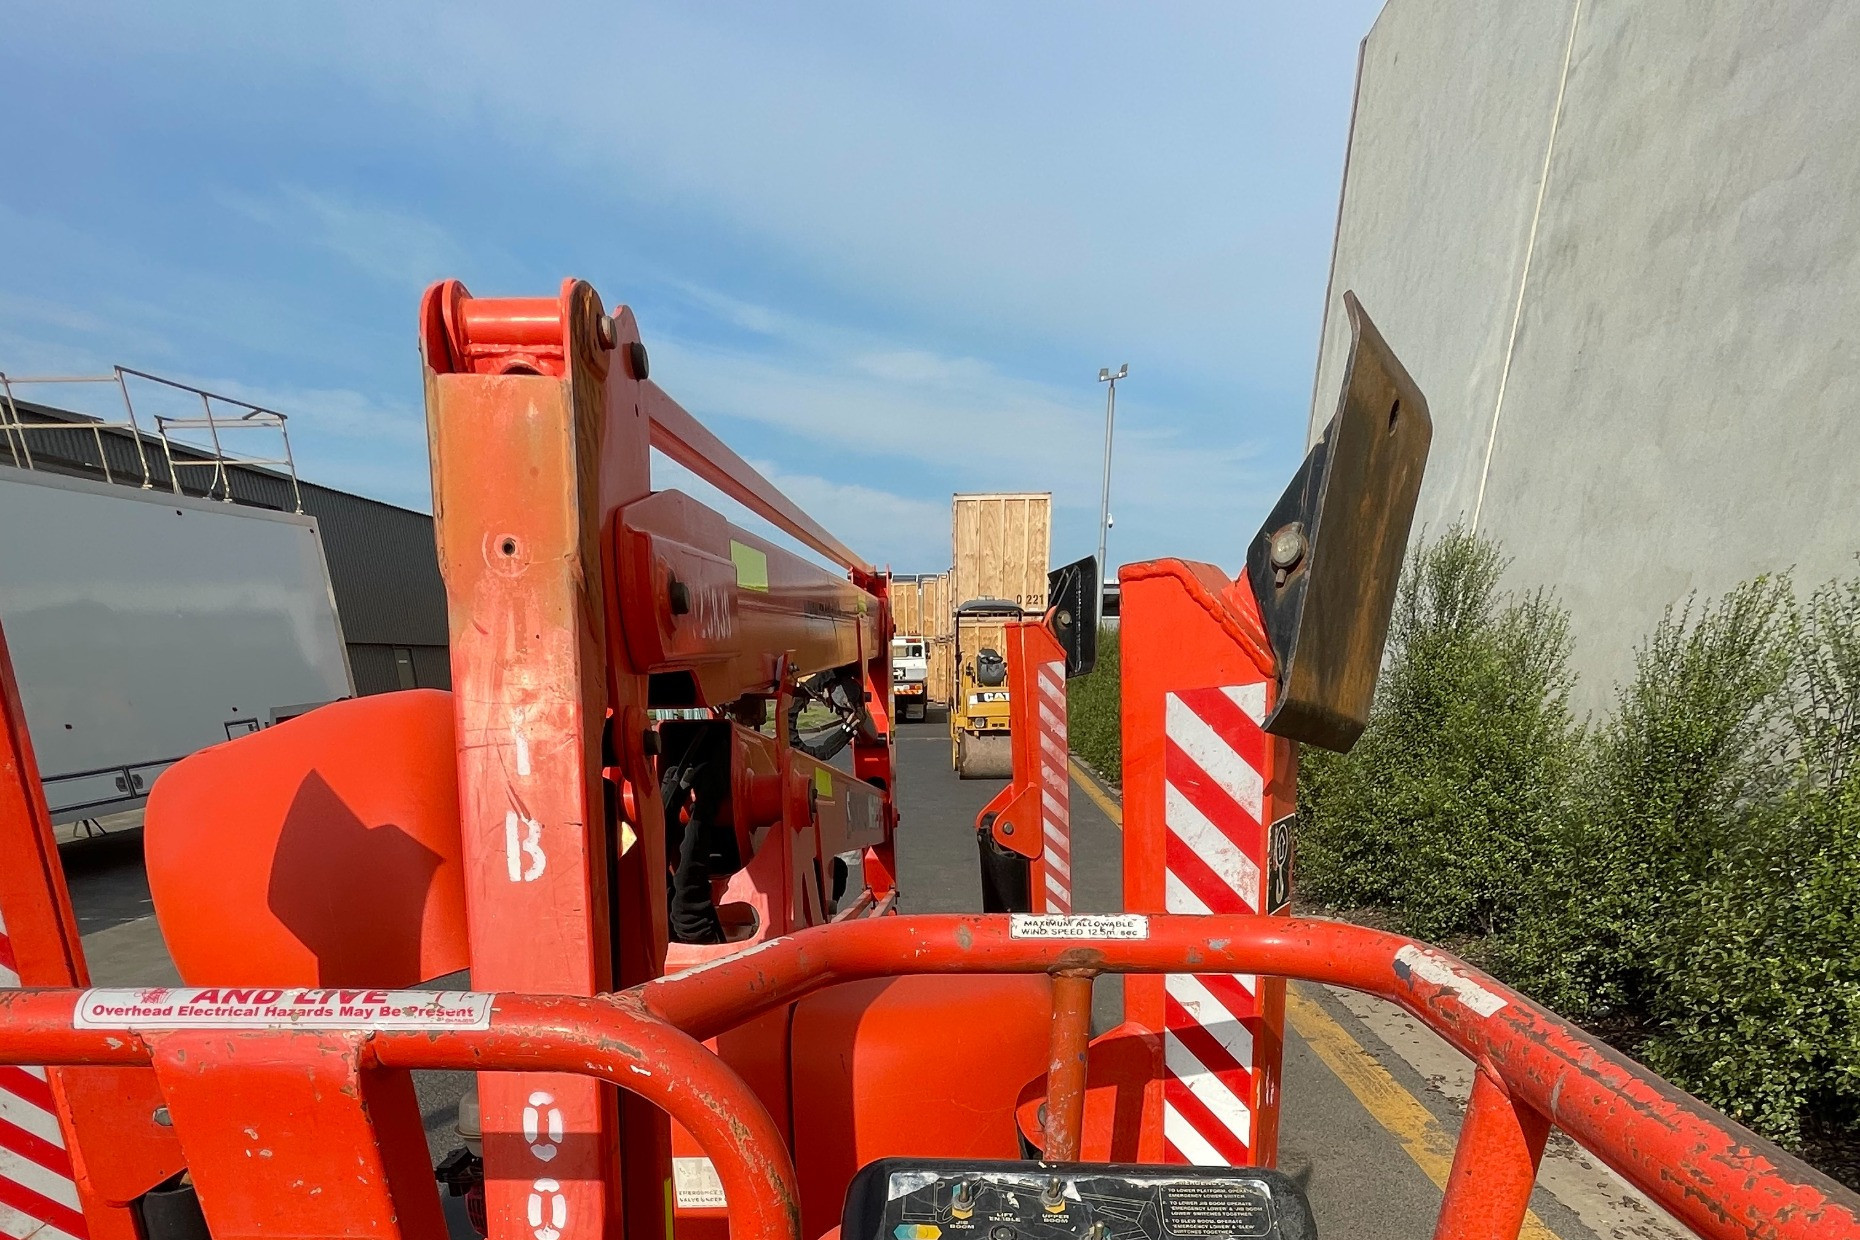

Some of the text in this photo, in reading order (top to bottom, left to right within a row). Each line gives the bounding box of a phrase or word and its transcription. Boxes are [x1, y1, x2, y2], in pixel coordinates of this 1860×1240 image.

[1026, 594, 1044, 605] 221
[984, 692, 1010, 702] CAT
[1076, 920, 1134, 928] ALLOWABLE
[1021, 928, 1048, 936] WIND
[1051, 928, 1084, 936] SPEED
[189, 989, 389, 1005] AND LIVE
[92, 1004, 475, 1020] Overhead Electrical Hazards May Be Present
